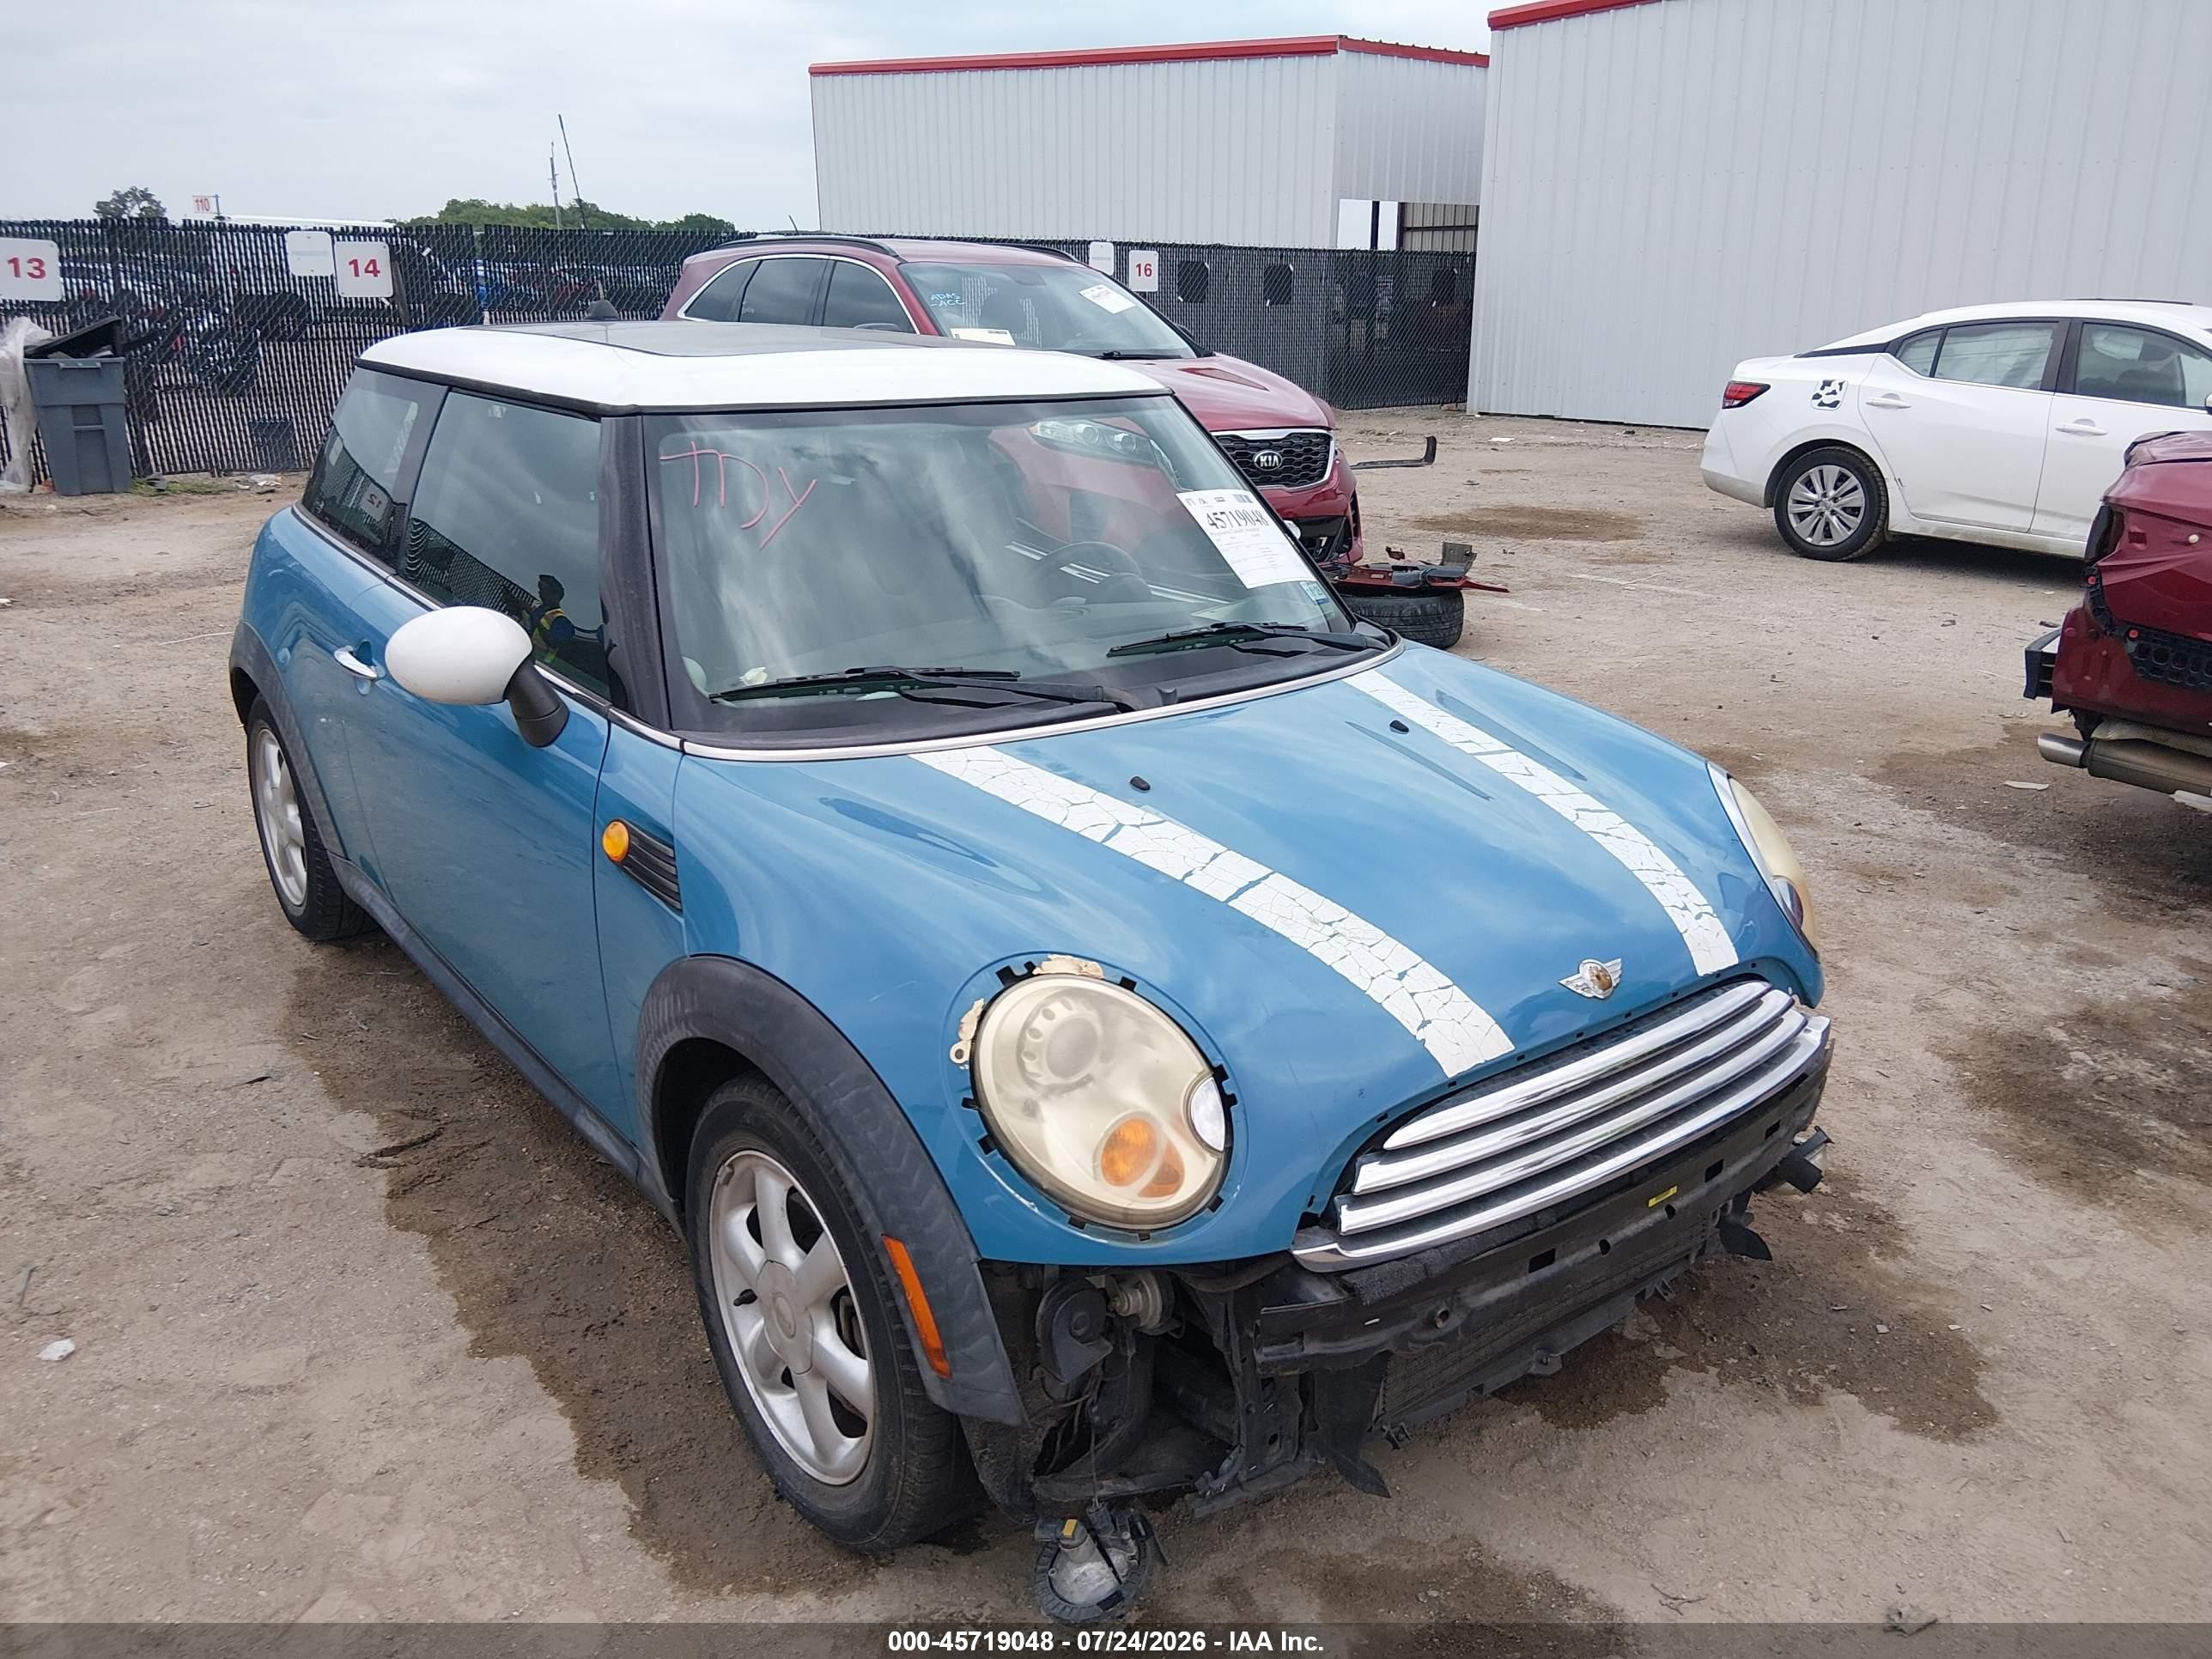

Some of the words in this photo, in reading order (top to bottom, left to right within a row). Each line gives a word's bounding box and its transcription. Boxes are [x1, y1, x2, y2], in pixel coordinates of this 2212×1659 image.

[195, 198, 210, 211] 110
[7, 257, 46, 279] 13
[349, 258, 380, 277] 14
[1135, 263, 1152, 277] 16
[1260, 455, 1279, 467] KIA
[1206, 508, 1269, 530] 45719048
